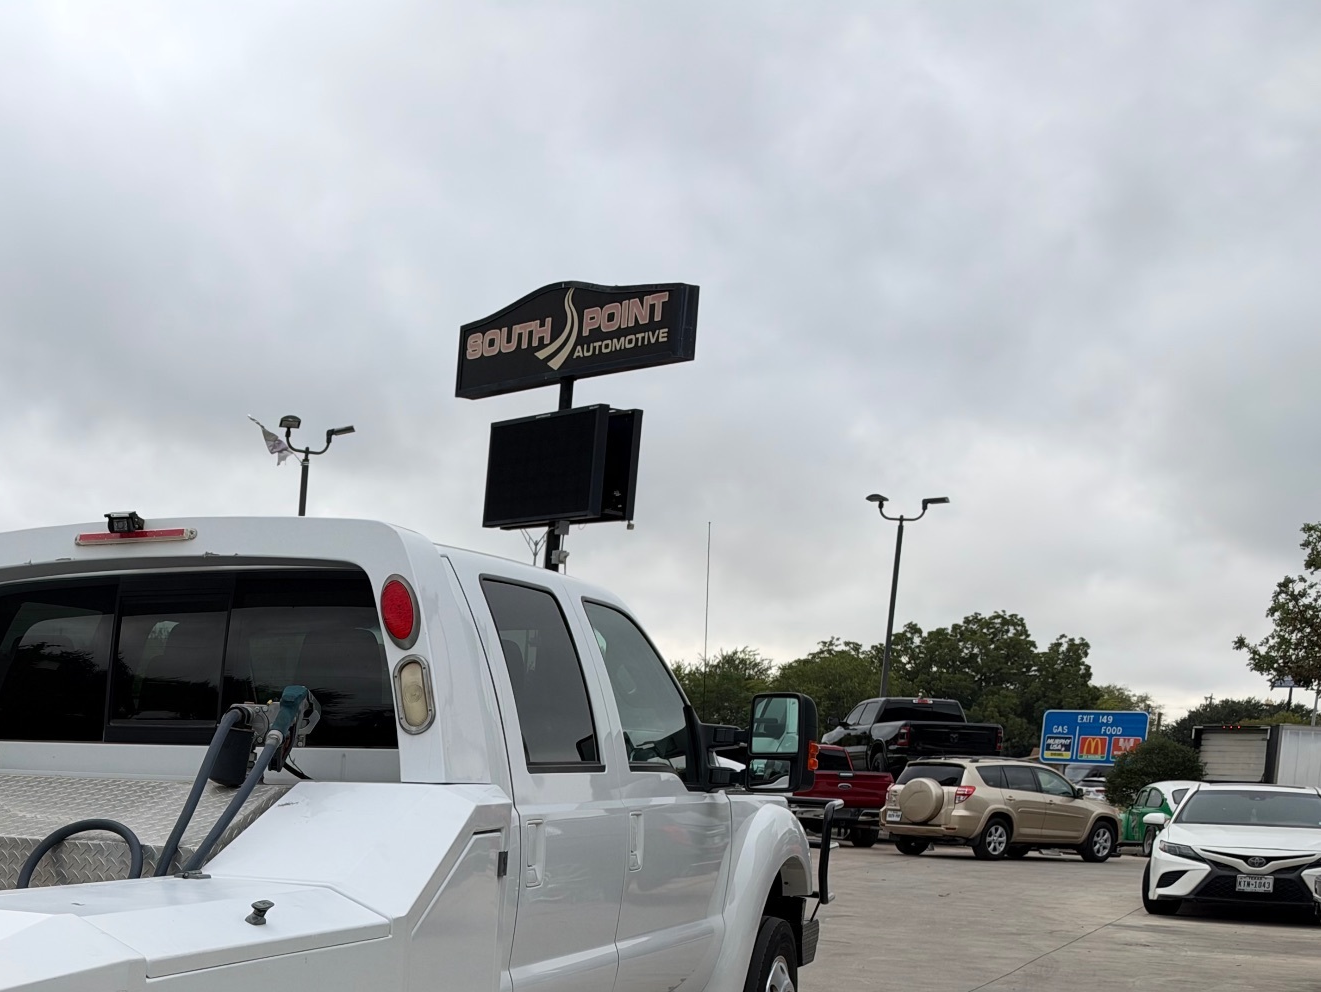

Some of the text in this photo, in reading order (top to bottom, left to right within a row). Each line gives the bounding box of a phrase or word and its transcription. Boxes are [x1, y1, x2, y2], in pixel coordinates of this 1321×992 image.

[466, 291, 669, 360] SOUTH POINT
[572, 328, 669, 359] AUTOMOTIVE
[1077, 714, 1113, 724] EXIT 149
[1052, 725, 1122, 735] GAS FOOD
